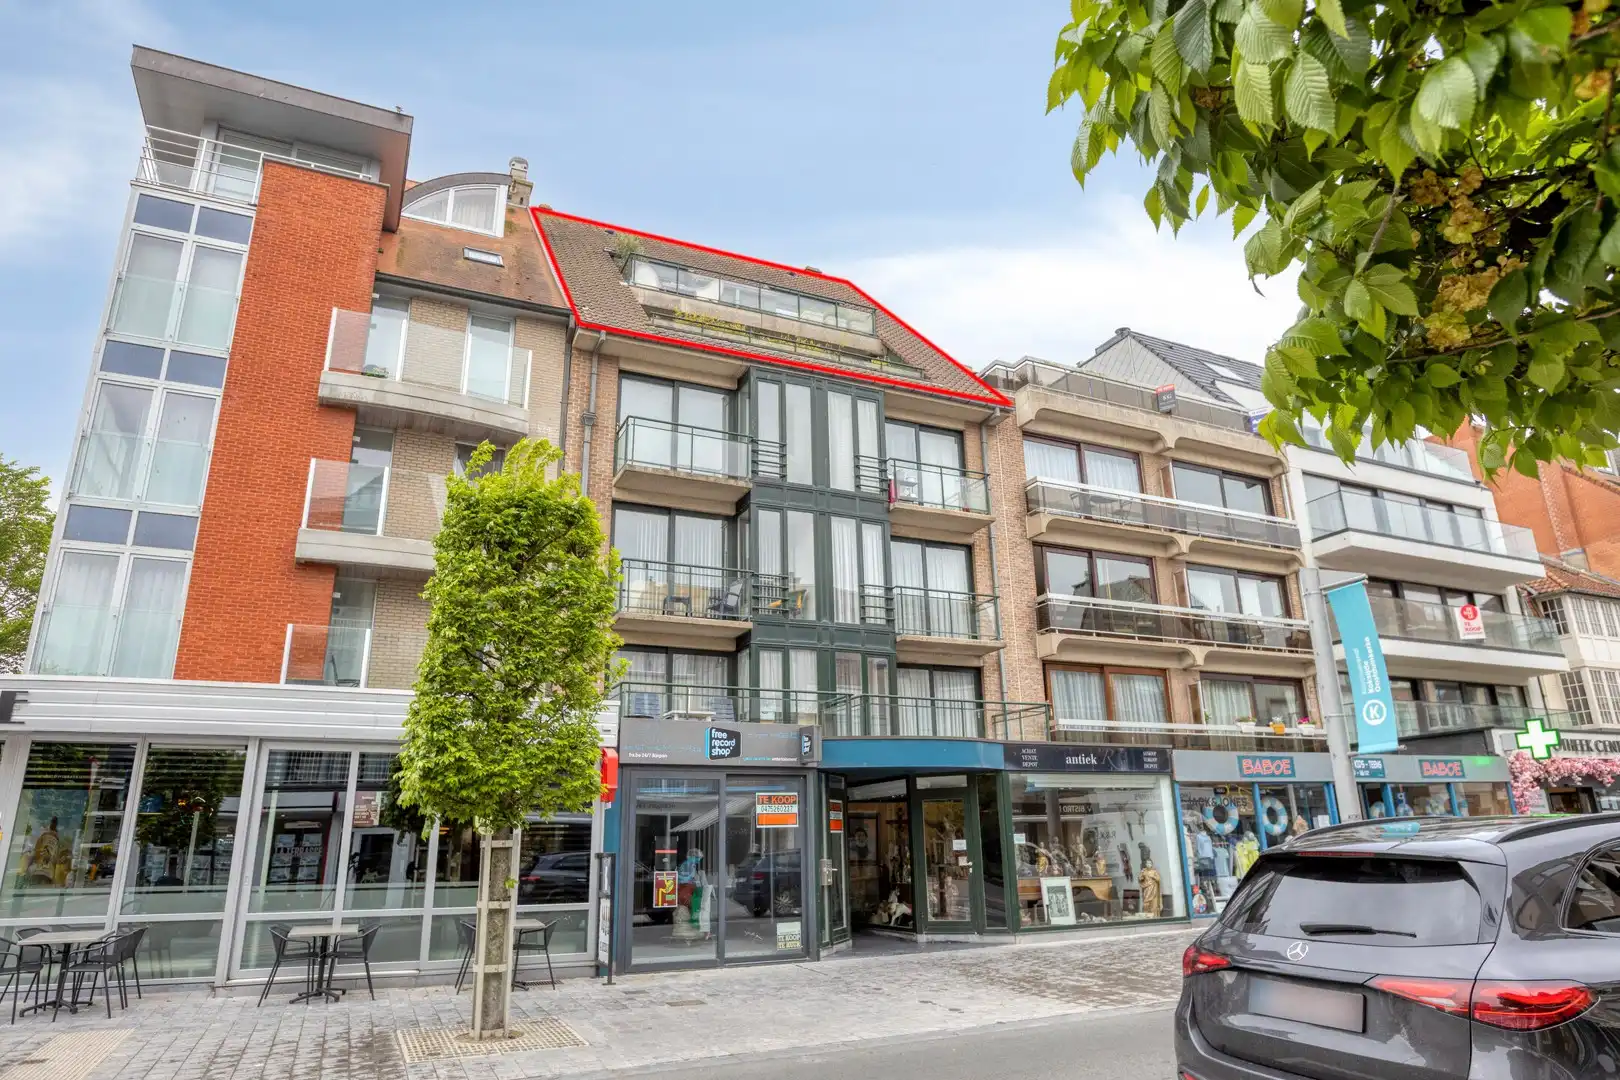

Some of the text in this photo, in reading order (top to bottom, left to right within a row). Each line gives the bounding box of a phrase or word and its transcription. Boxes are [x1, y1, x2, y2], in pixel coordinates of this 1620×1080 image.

[711, 728, 728, 739] free
[711, 738, 736, 747] record
[711, 747, 733, 757] shop
[1065, 753, 1098, 765] antiek
[1242, 758, 1292, 775] BABOE
[1422, 761, 1462, 776] BABOE
[758, 795, 796, 804] TE KOOP
